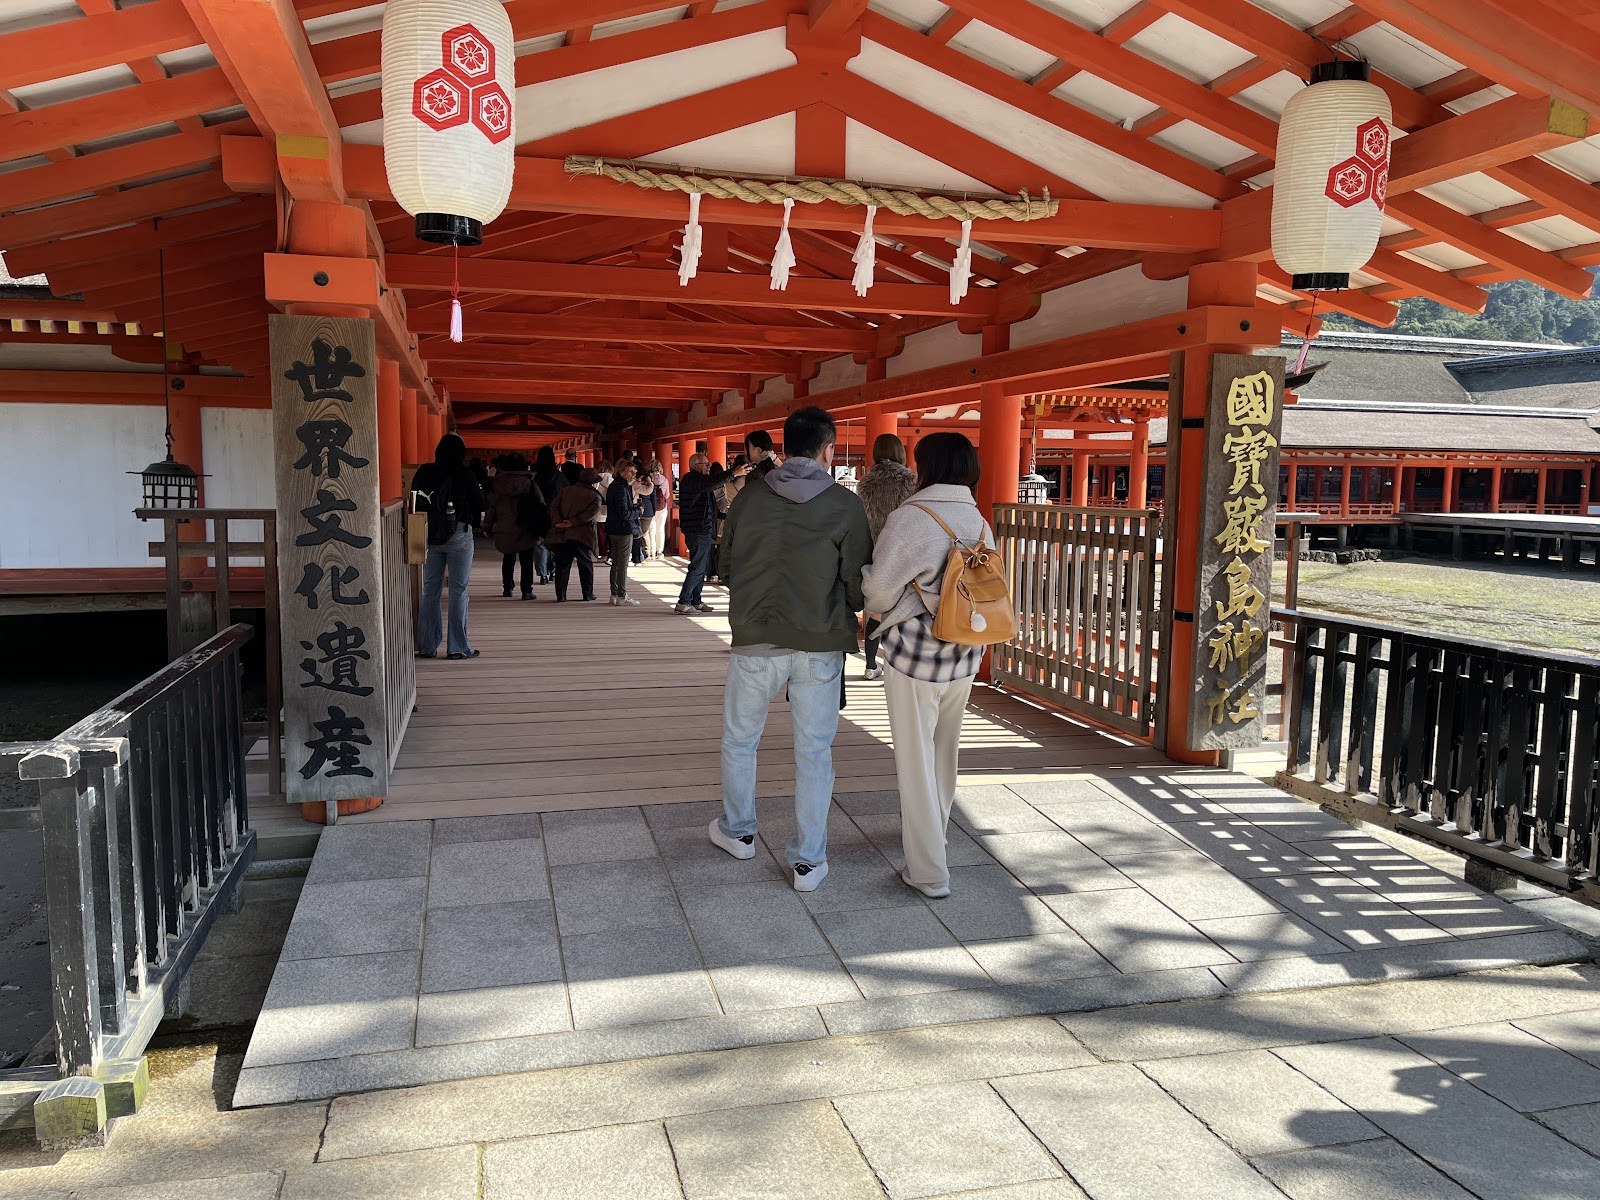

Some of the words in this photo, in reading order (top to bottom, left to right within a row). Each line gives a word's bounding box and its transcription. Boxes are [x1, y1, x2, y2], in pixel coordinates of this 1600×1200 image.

[283, 337, 374, 780] 世界文化遺産
